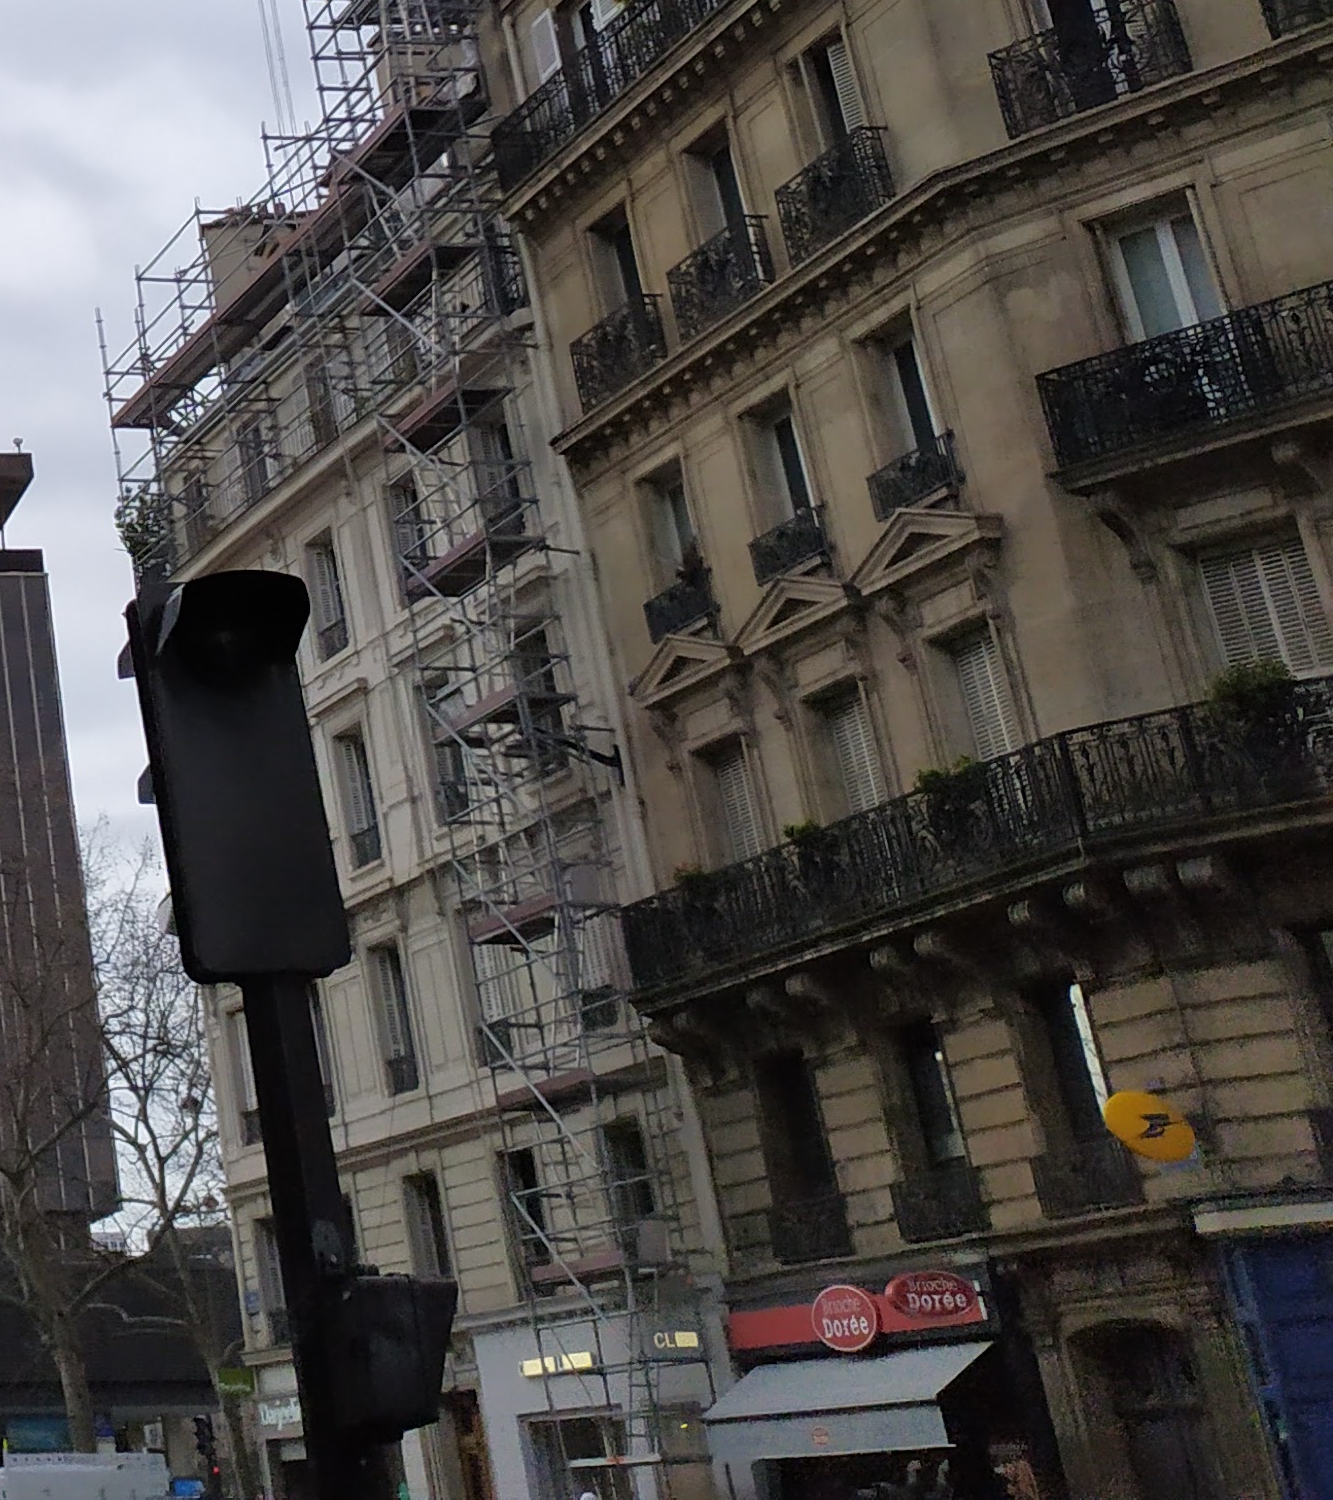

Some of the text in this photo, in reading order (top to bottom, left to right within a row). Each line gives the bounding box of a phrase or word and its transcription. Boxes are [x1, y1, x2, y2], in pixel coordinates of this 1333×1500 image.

[907, 1277, 959, 1292] Brioche
[906, 1291, 968, 1312] Dorée
[821, 1314, 870, 1340] Dorée
